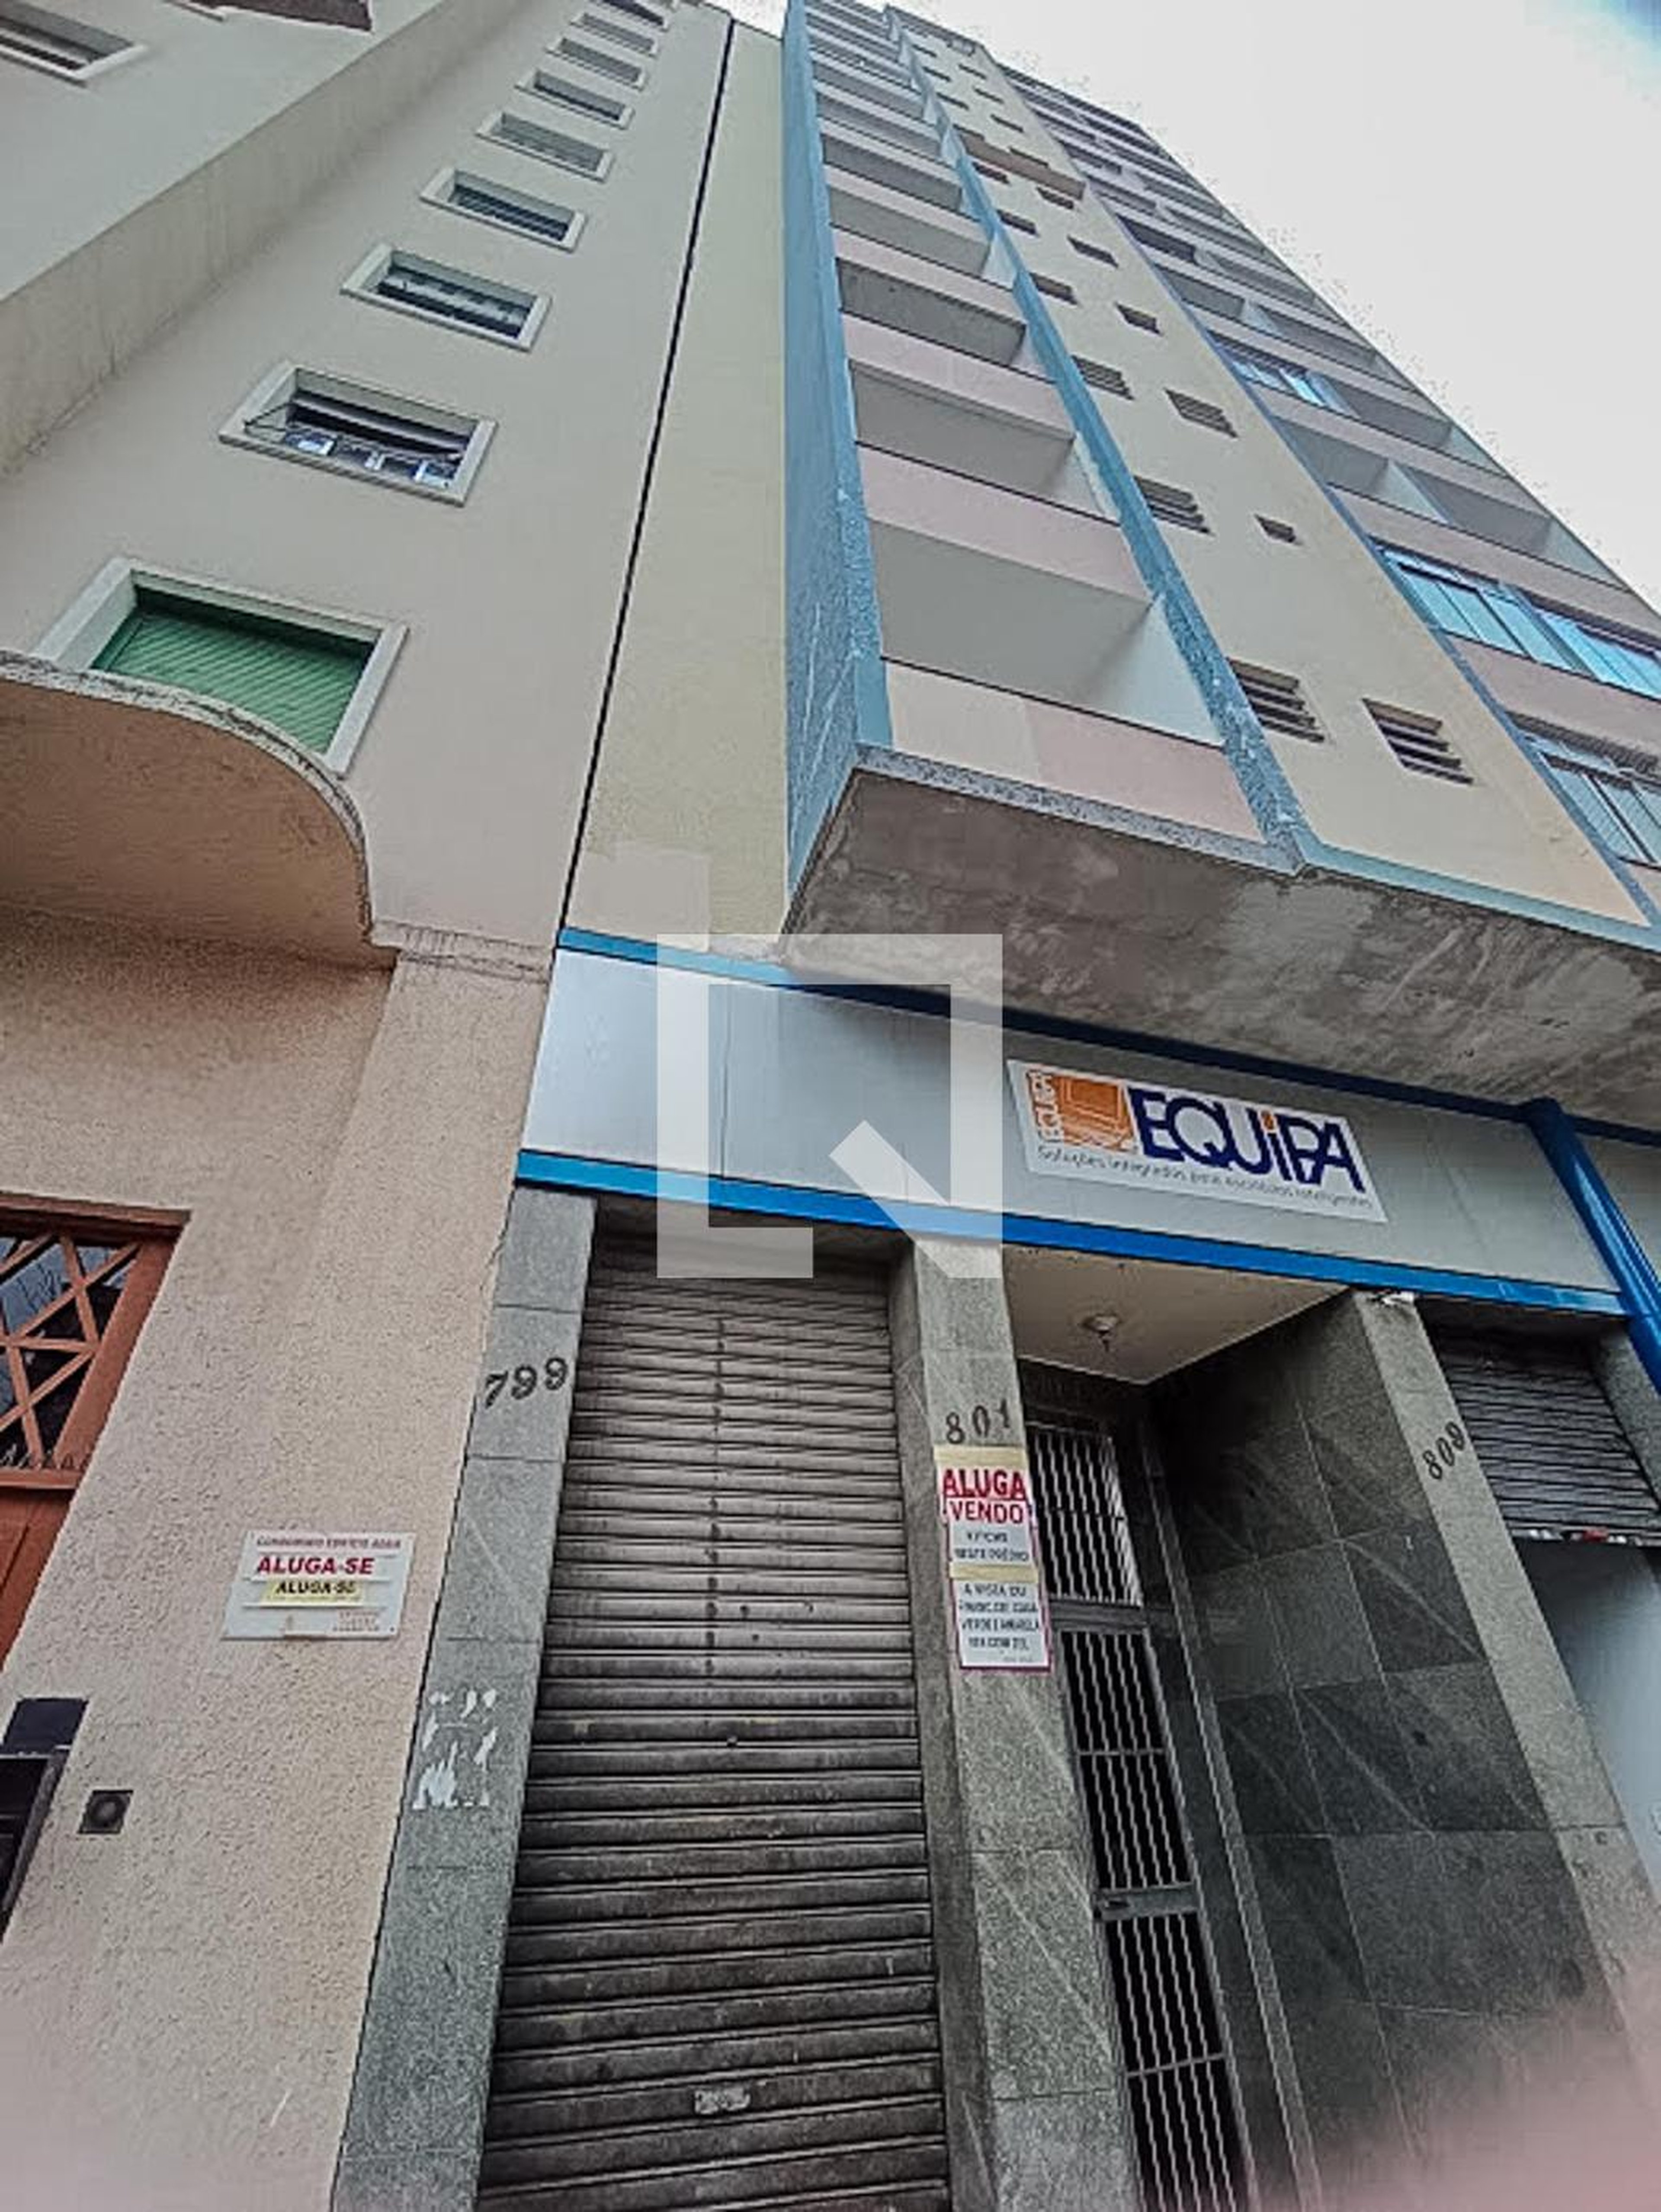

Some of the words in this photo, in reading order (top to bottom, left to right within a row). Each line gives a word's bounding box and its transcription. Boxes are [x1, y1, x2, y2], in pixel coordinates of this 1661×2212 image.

[485, 1357, 568, 1409] 799
[946, 1399, 1010, 1445] 801
[1423, 1421, 1465, 1481] 809
[943, 1469, 1026, 1500] ALUGA
[949, 1500, 1023, 1524] VENDO
[257, 1557, 375, 1575] ALUGA-SE
[276, 1581, 357, 1594] ALUGA-SE
